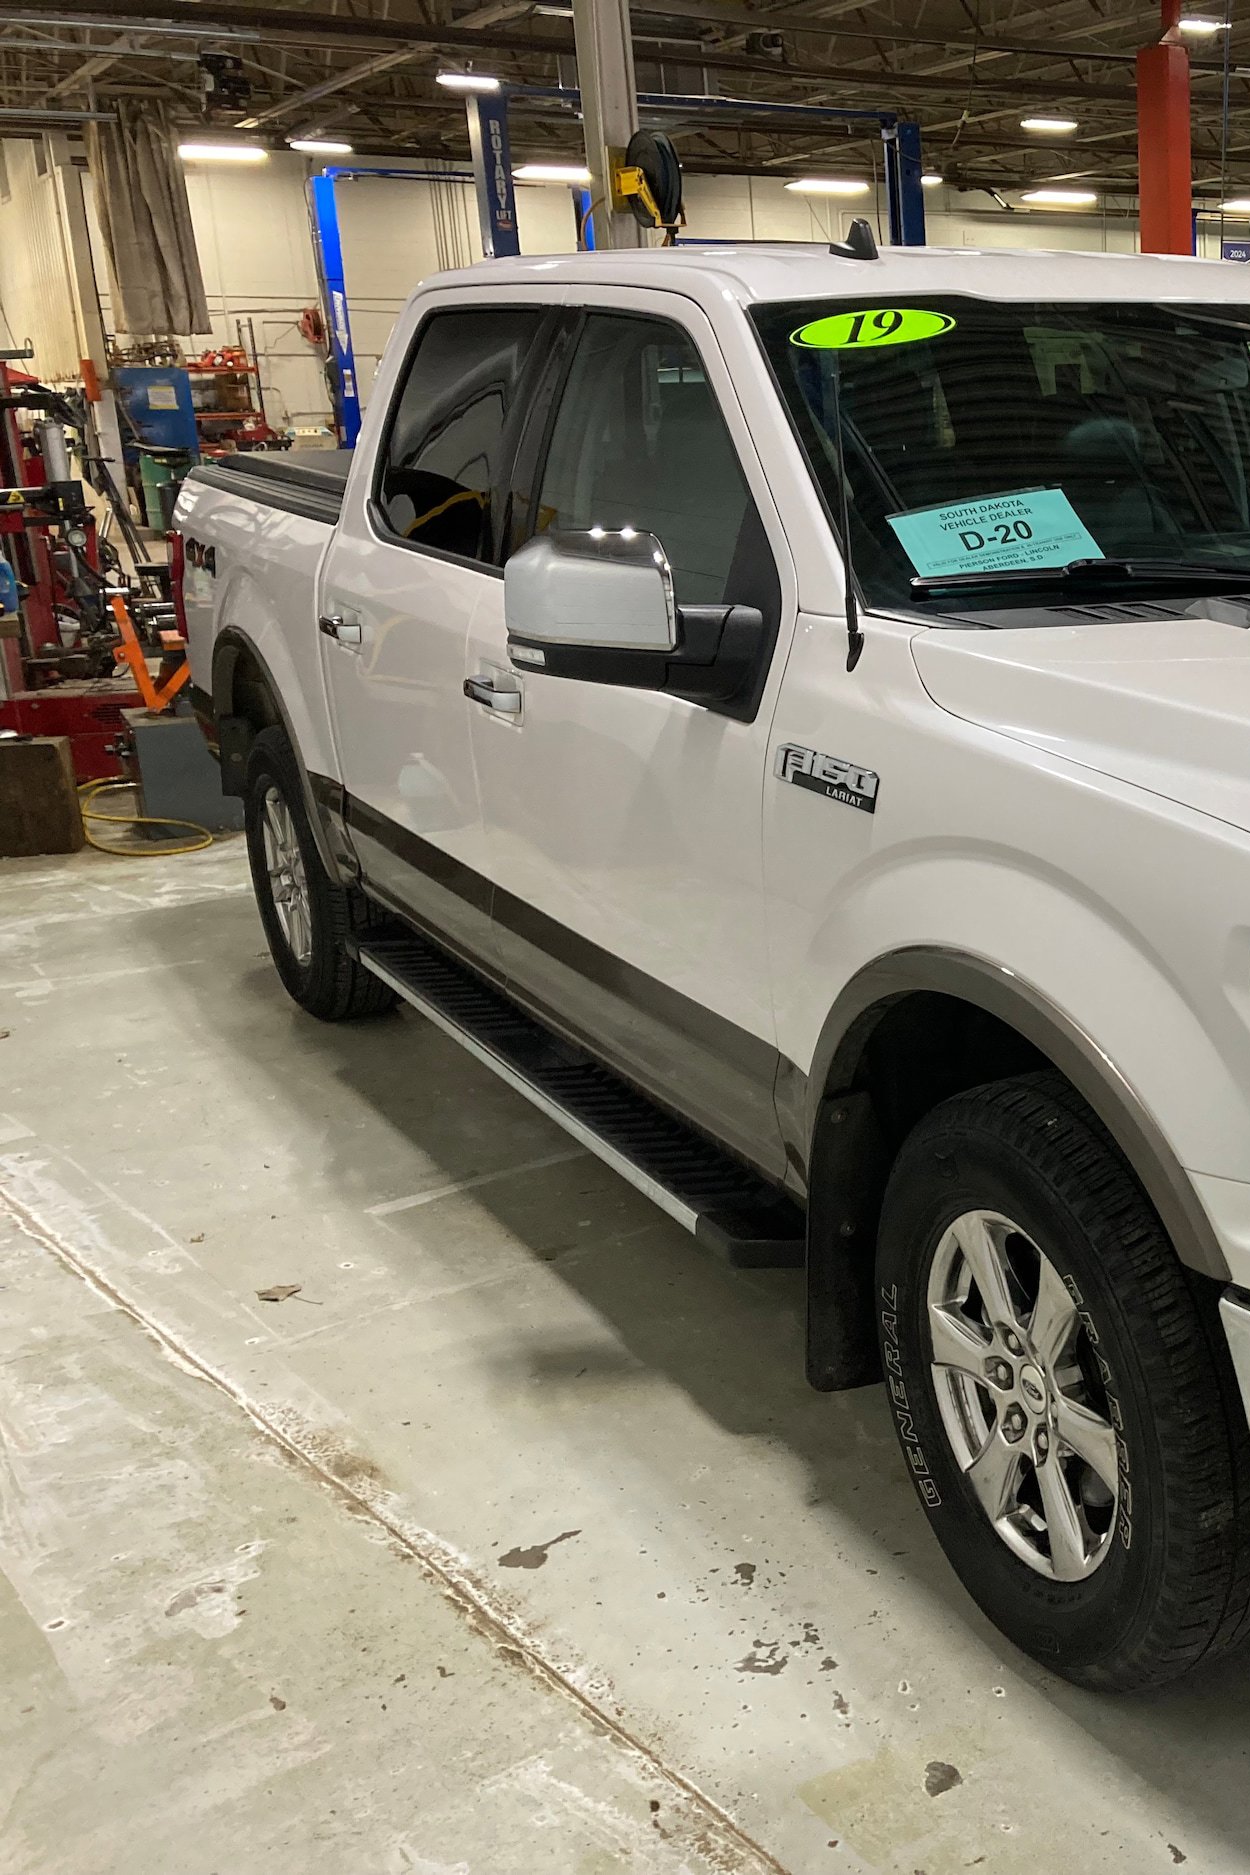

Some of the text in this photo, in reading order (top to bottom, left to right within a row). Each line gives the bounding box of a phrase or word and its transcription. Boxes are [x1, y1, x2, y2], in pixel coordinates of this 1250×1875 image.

[488, 119, 507, 209] ROTARY
[496, 210, 512, 221] LIFT
[1230, 249, 1246, 258] 2024
[840, 310, 904, 345] 19
[939, 499, 1025, 521] SOUTH DAKOTA
[940, 507, 1033, 532] VEHICLE DEALER
[959, 520, 1033, 551] D-20
[959, 556, 995, 570] PIERSON
[996, 552, 1020, 565] FORD
[1025, 544, 1060, 558] LINCOLN
[826, 785, 863, 807] LARIAT
[881, 1284, 942, 1508] GENERAL
